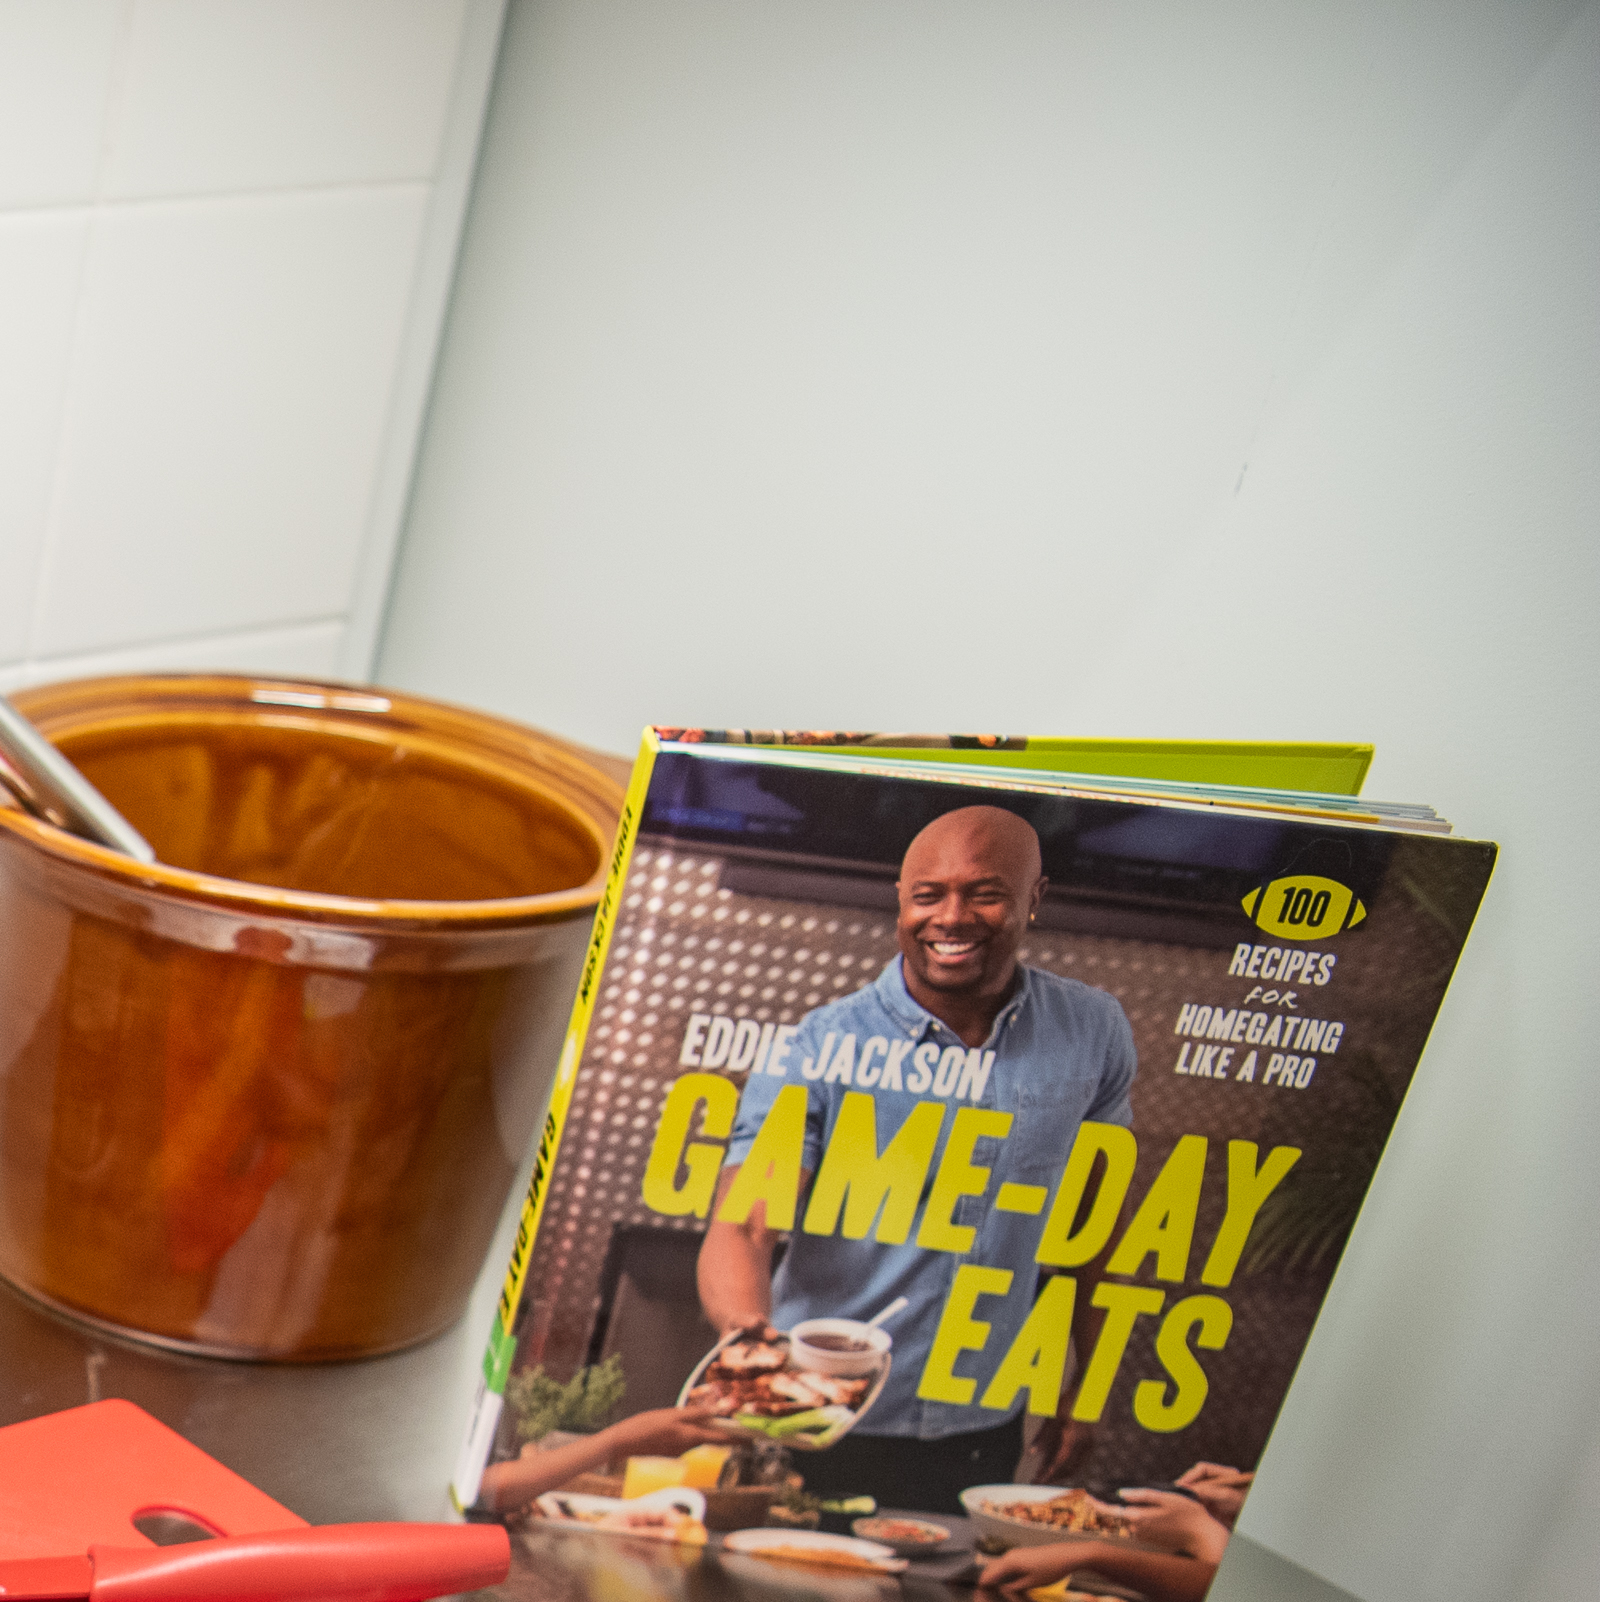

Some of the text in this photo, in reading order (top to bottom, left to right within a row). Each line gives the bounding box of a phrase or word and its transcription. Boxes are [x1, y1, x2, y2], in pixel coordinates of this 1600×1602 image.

[1277, 886, 1332, 928] 100
[1228, 942, 1337, 986] RECIPES
[1174, 1003, 1345, 1054] HOMEGATING
[678, 1013, 996, 1102] EDDIE JACKSON
[1174, 1042, 1318, 1090] LIKE A PRO
[642, 1072, 1302, 1288] GAME-DAY
[917, 1263, 1234, 1434] EATS
